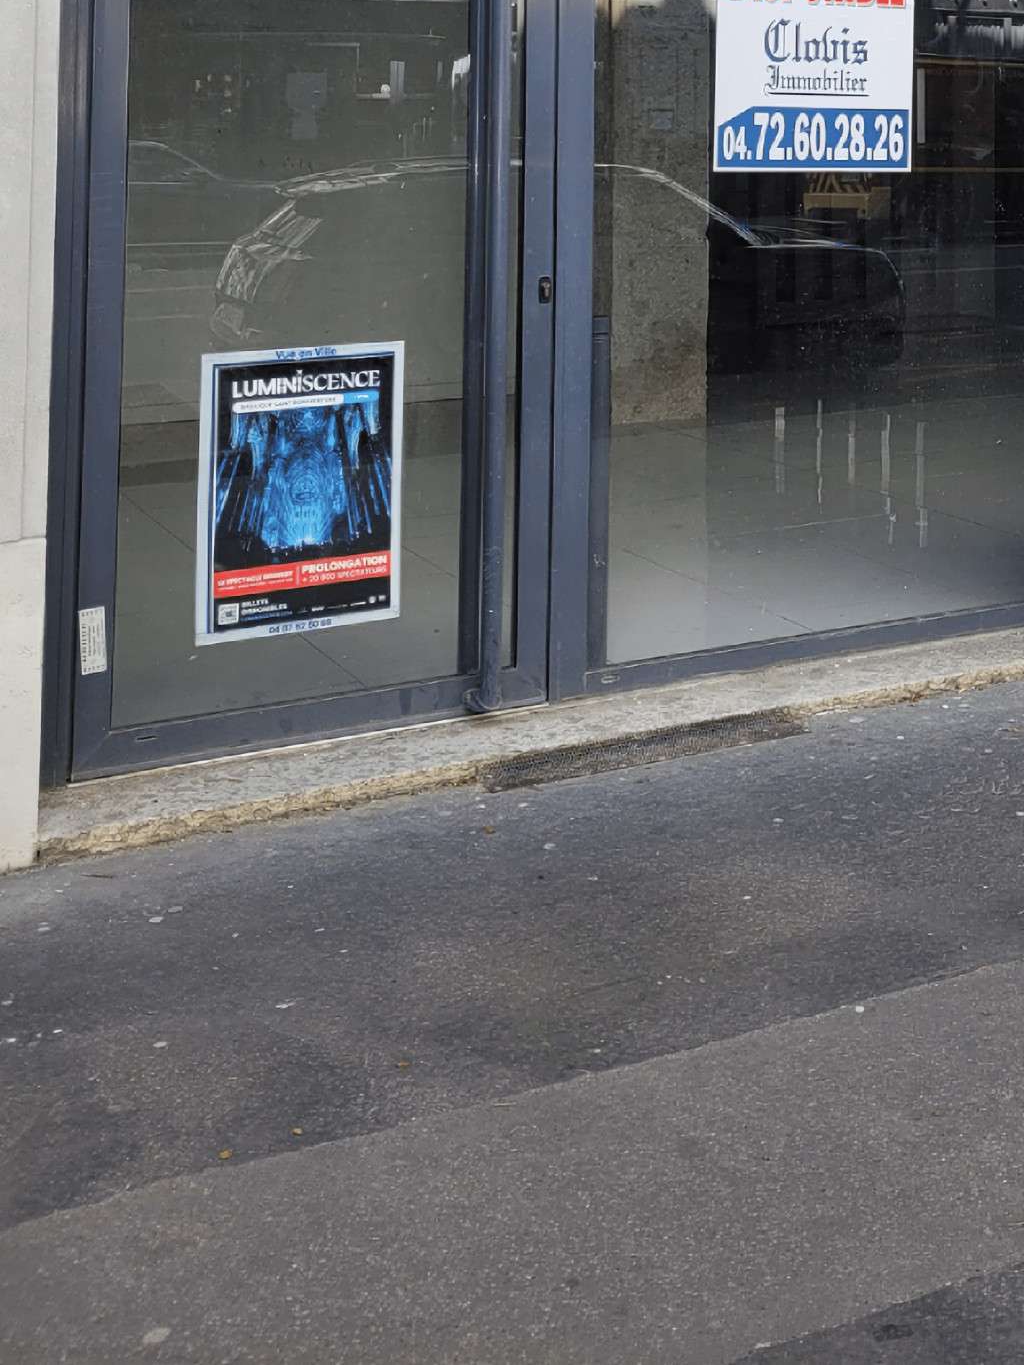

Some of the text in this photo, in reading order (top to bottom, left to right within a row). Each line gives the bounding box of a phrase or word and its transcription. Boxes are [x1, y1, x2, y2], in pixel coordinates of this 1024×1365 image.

[763, 18, 869, 66] Clovis
[764, 65, 868, 93] Immobilier
[722, 112, 904, 163] 04.72.60.28.26
[302, 555, 388, 574] PROLONGATION
